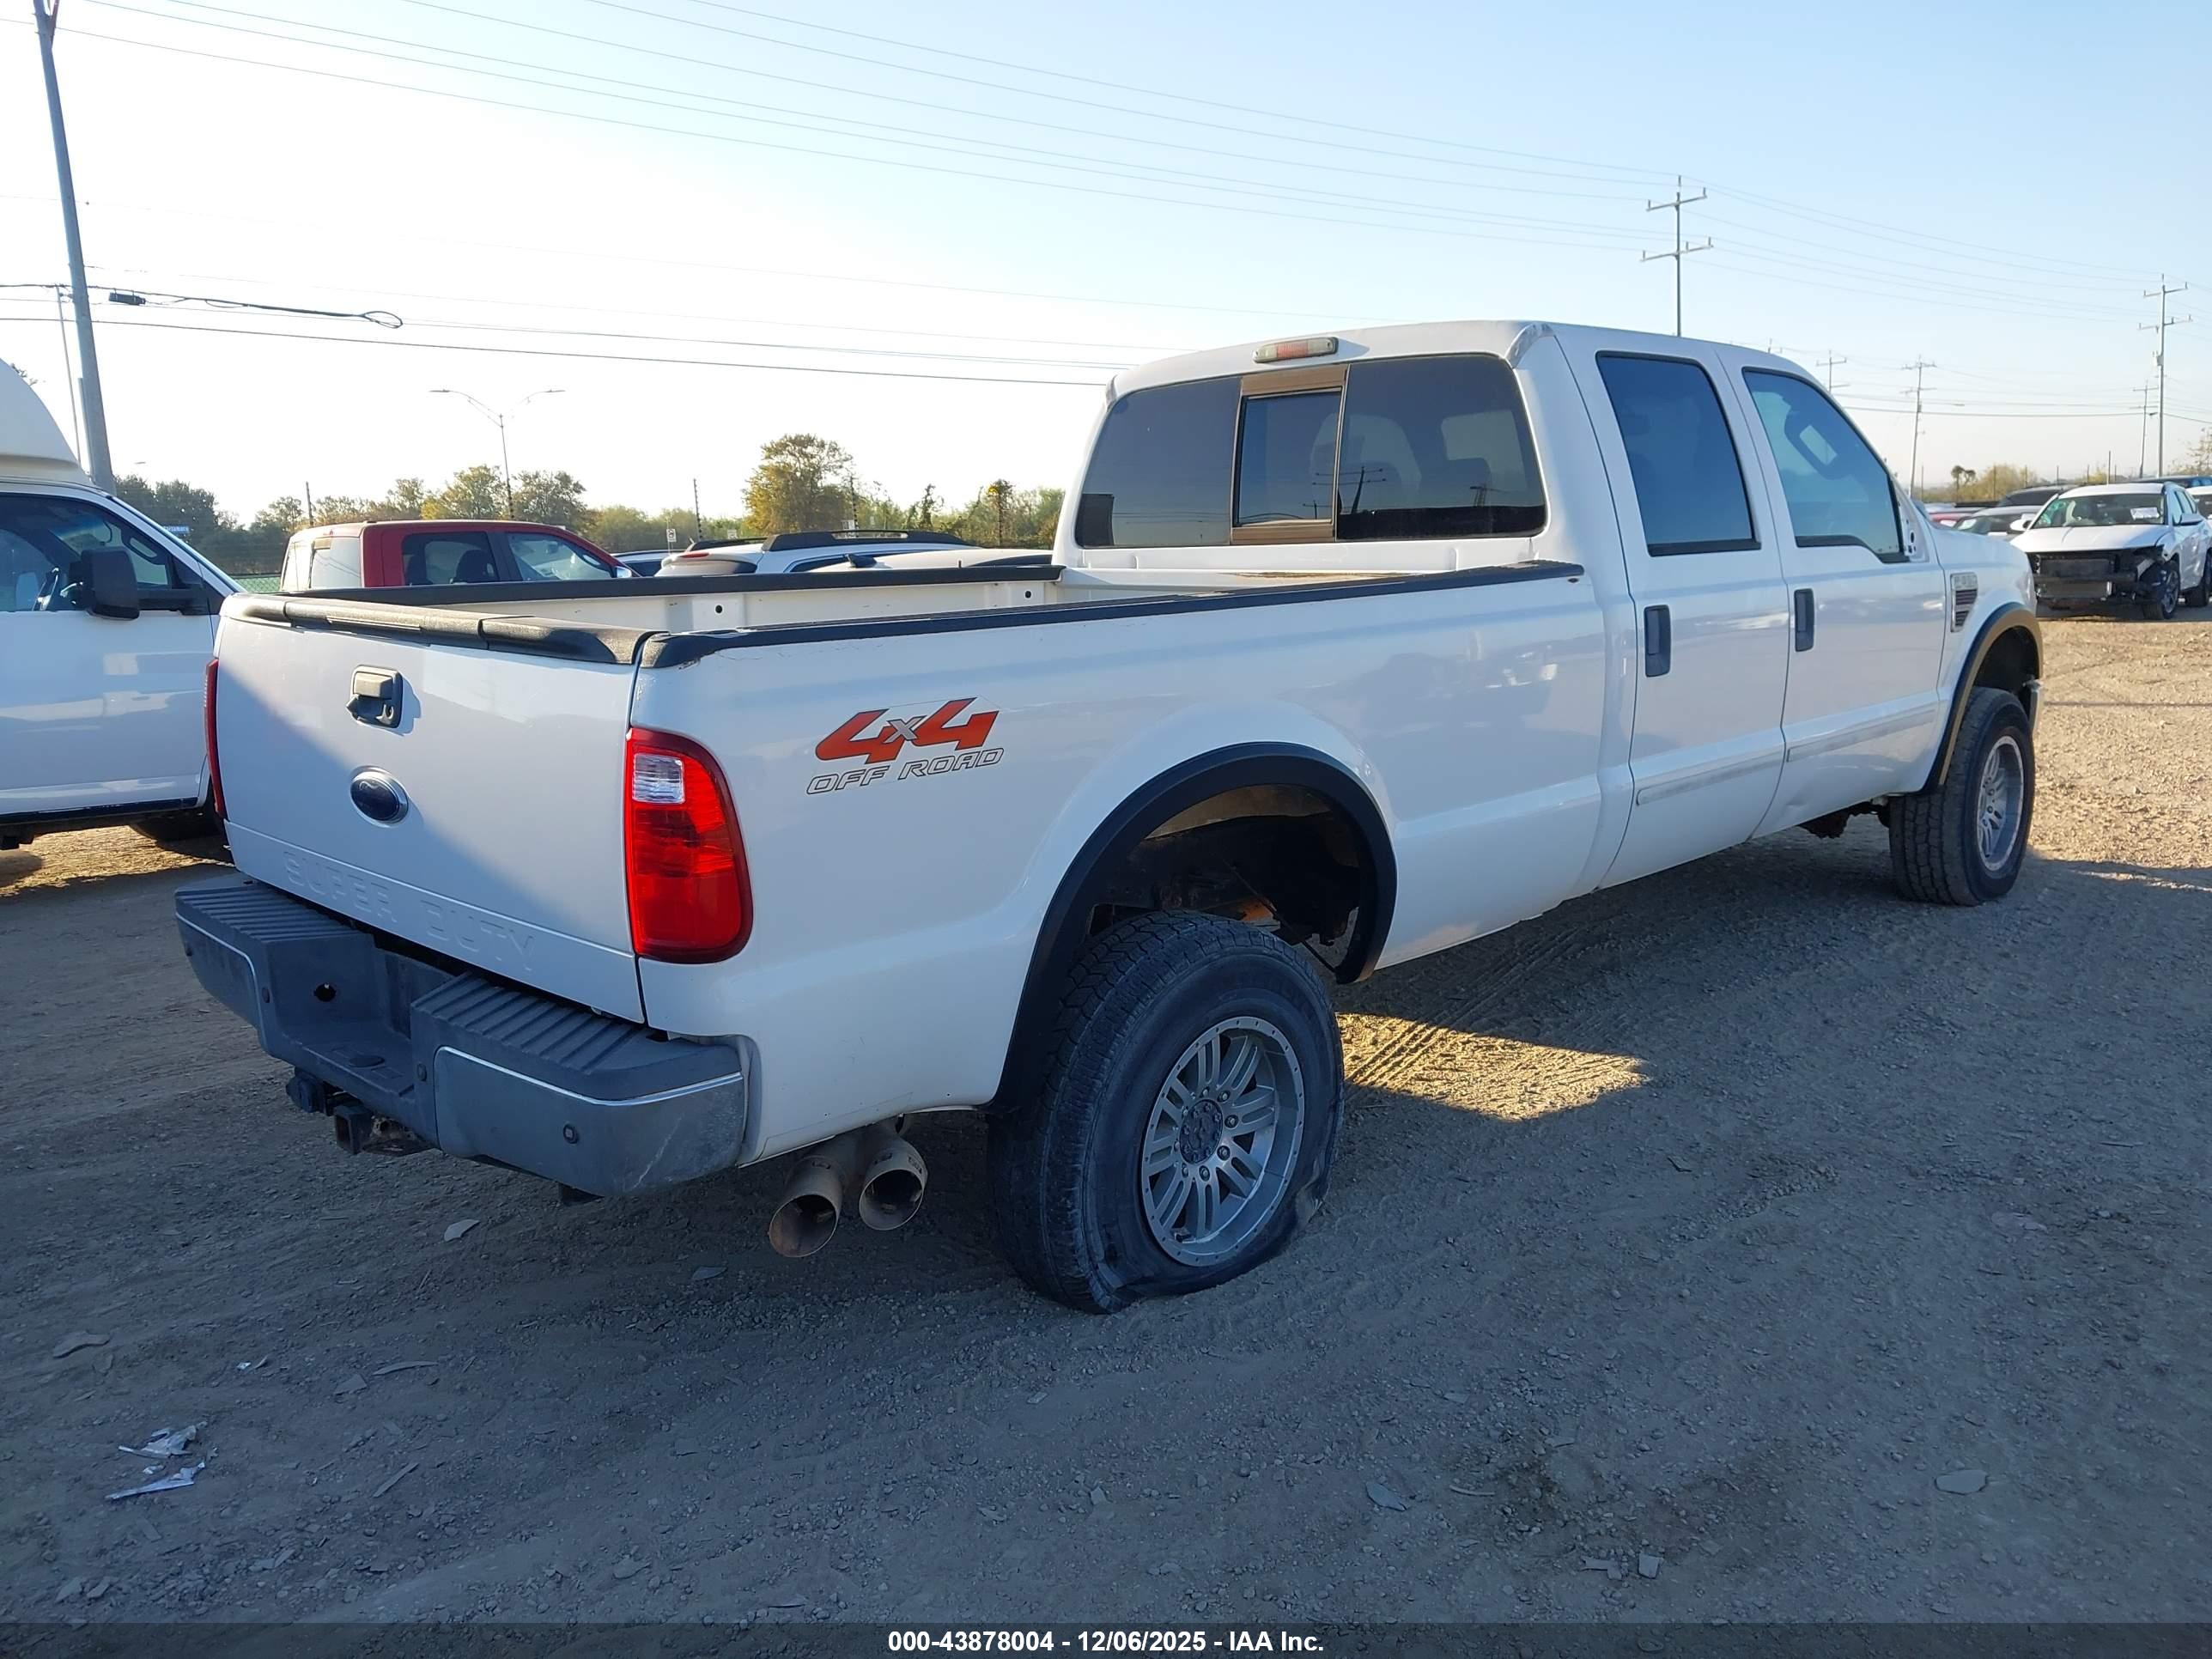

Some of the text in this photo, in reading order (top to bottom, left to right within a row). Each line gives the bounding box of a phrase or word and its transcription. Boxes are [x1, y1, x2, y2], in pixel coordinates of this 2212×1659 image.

[806, 747, 1005, 795] OFF ROAD
[283, 851, 398, 924] SUPER
